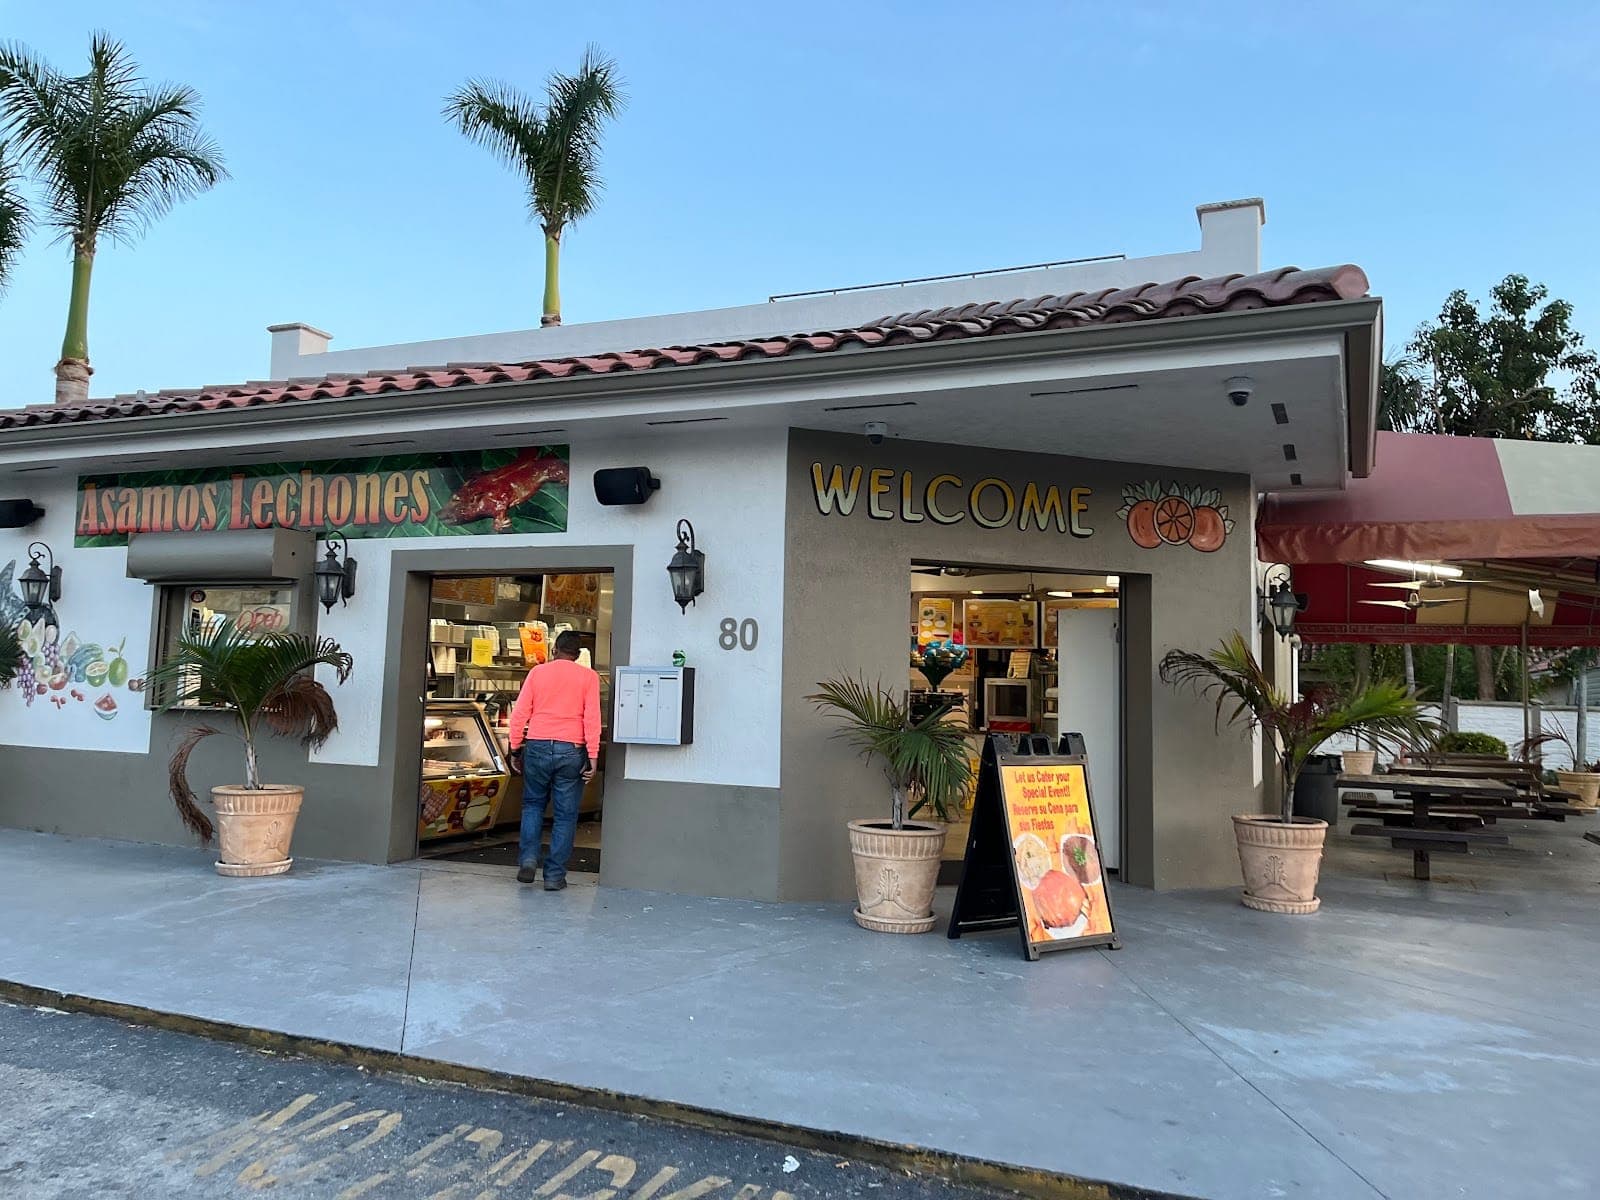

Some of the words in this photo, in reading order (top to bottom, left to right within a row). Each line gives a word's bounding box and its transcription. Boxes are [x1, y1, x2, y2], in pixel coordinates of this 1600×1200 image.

[76, 482, 218, 536] Asamos
[228, 469, 431, 530] Lechones
[811, 461, 1095, 539] WELCOME
[718, 617, 759, 651] 80
[1015, 771, 1026, 783] Let
[1027, 774, 1035, 783] us
[1036, 770, 1054, 783] Cater
[1056, 772, 1070, 785] your
[1022, 786, 1047, 801] Special
[1012, 803, 1038, 816] Reserve
[1039, 805, 1047, 814] su
[1065, 804, 1078, 816] para
[1031, 818, 1055, 831] Fiestas
